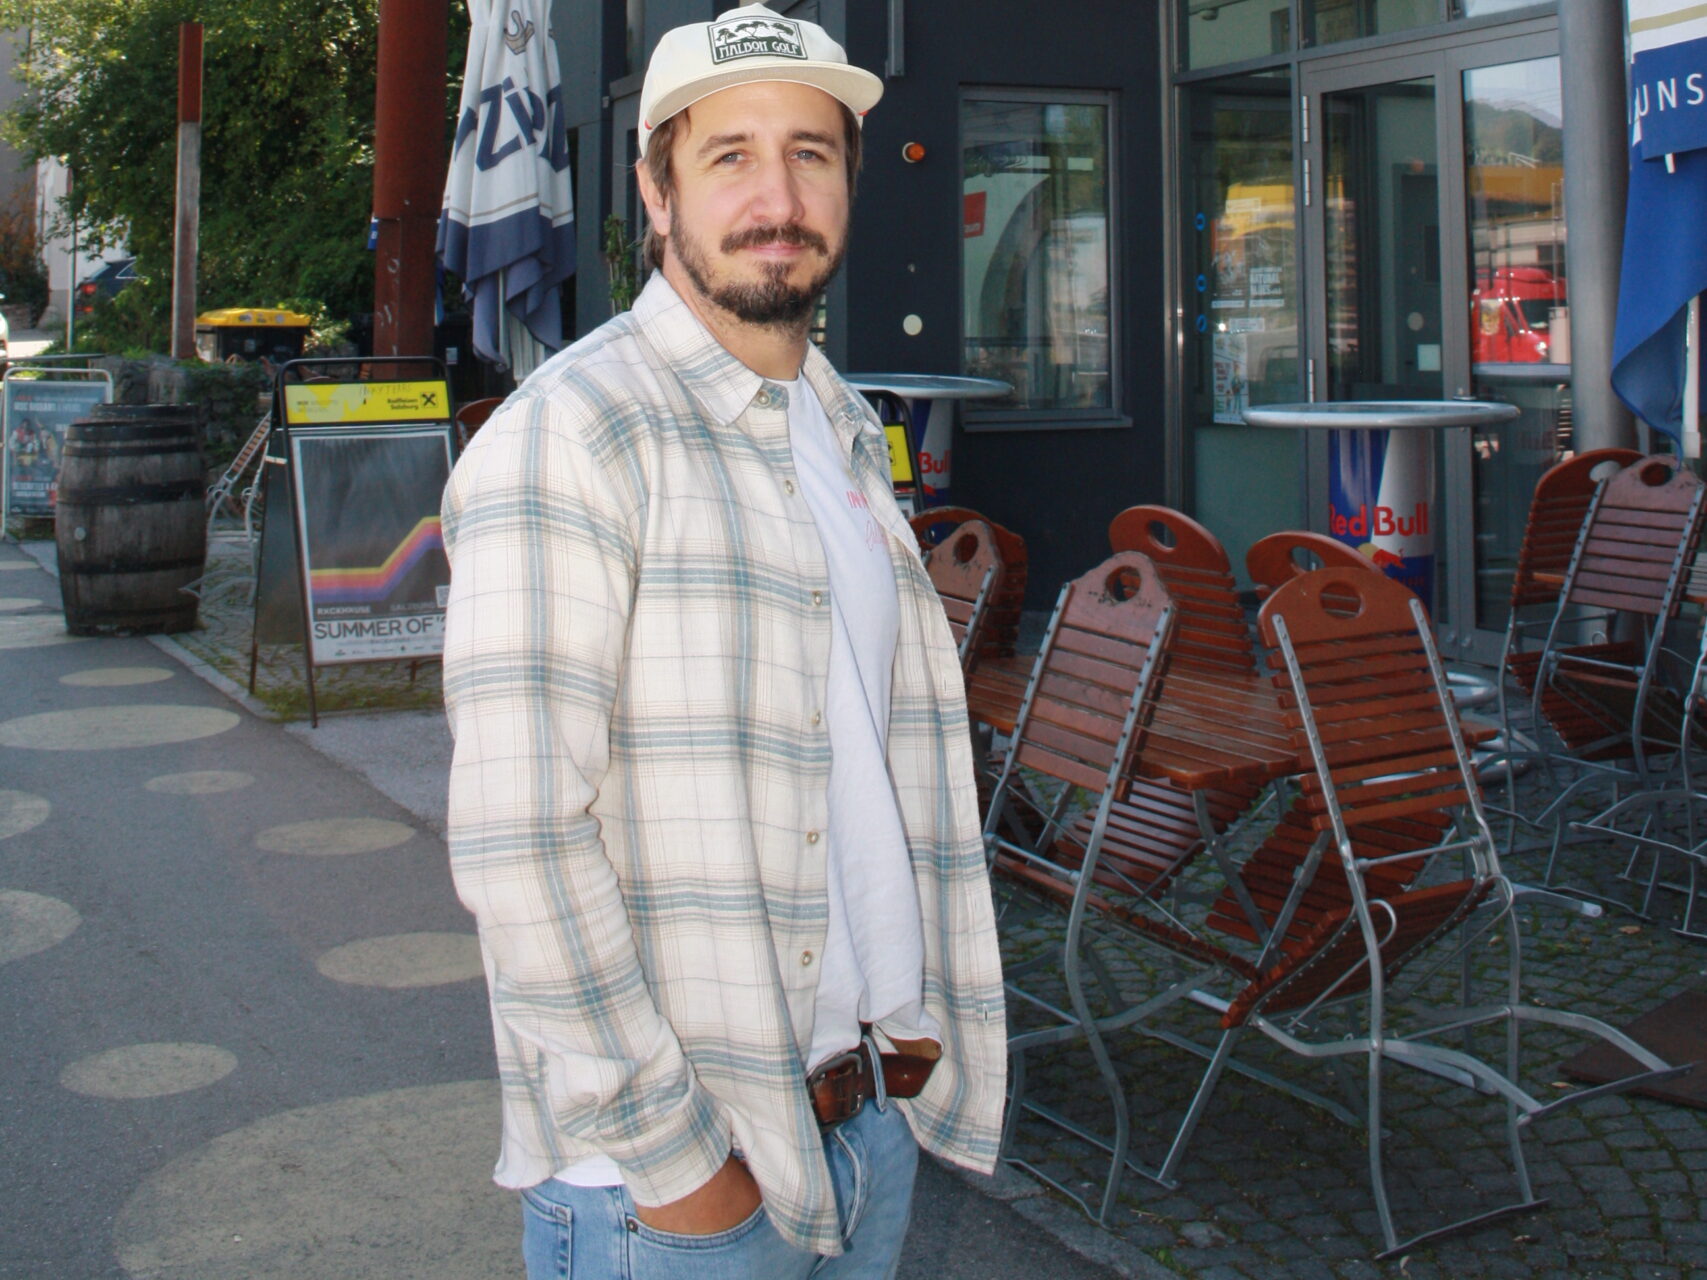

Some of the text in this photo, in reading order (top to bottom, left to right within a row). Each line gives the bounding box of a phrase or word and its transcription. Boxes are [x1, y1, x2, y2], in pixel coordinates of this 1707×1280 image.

[719, 40, 798, 59] MALBON GOLF
[1373, 502, 1428, 537] Bull
[314, 619, 402, 640] SUMMER
[406, 616, 434, 634] OF
